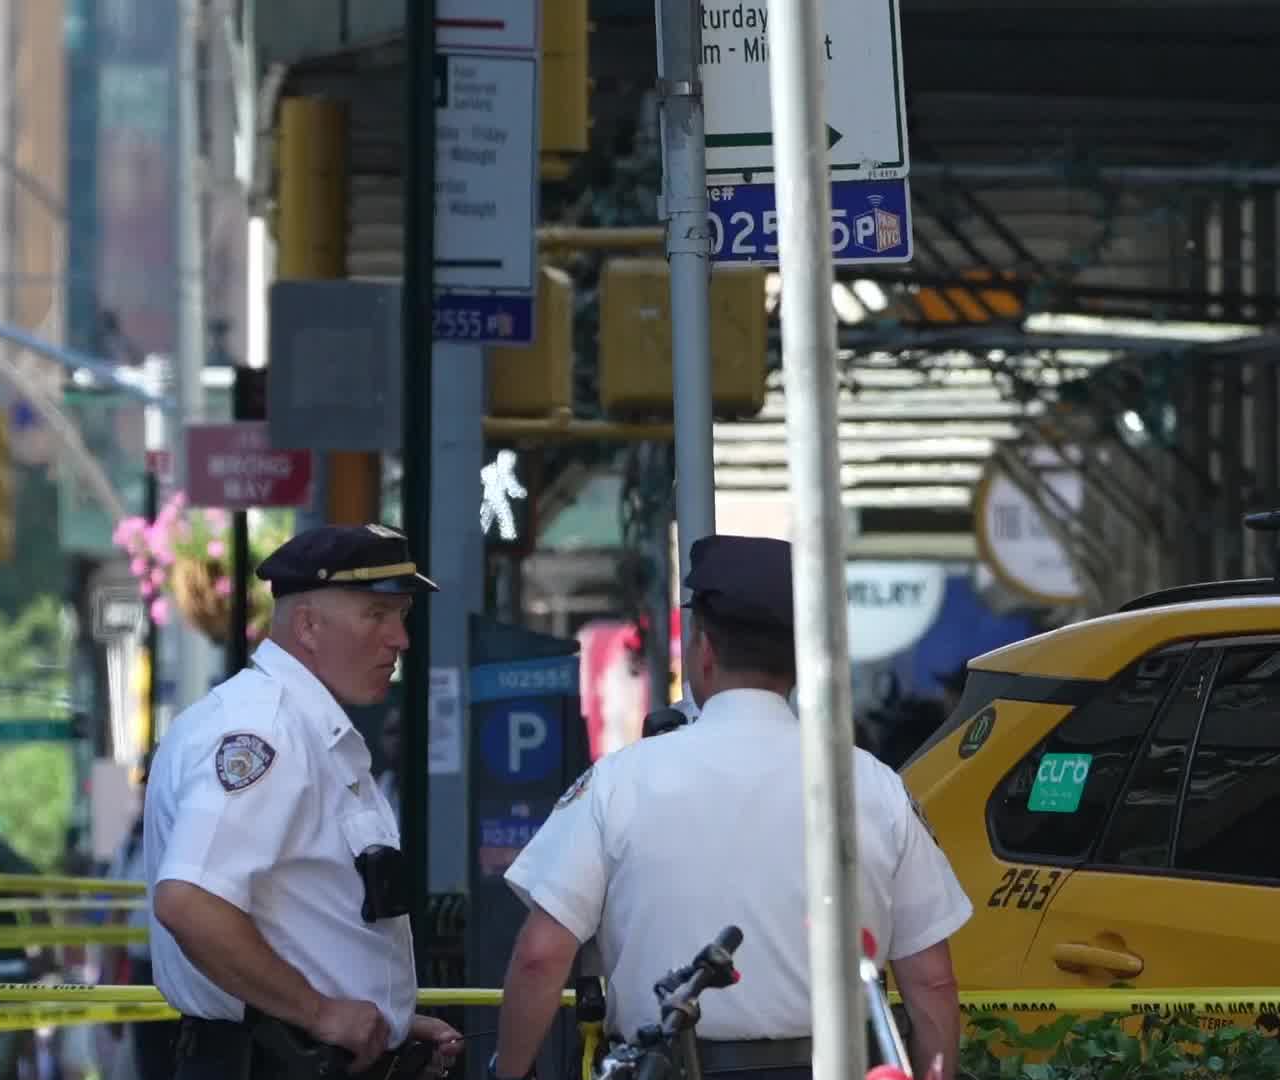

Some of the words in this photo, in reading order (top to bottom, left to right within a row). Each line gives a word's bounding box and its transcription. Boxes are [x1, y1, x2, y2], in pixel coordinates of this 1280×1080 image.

[701, 3, 768, 32] turday
[702, 43, 721, 65] m
[706, 185, 735, 201] e#
[707, 208, 850, 255] 0255
[431, 309, 481, 337] 2555
[508, 711, 548, 773] P
[1038, 757, 1089, 785] curb
[987, 867, 1063, 911] 2F63
